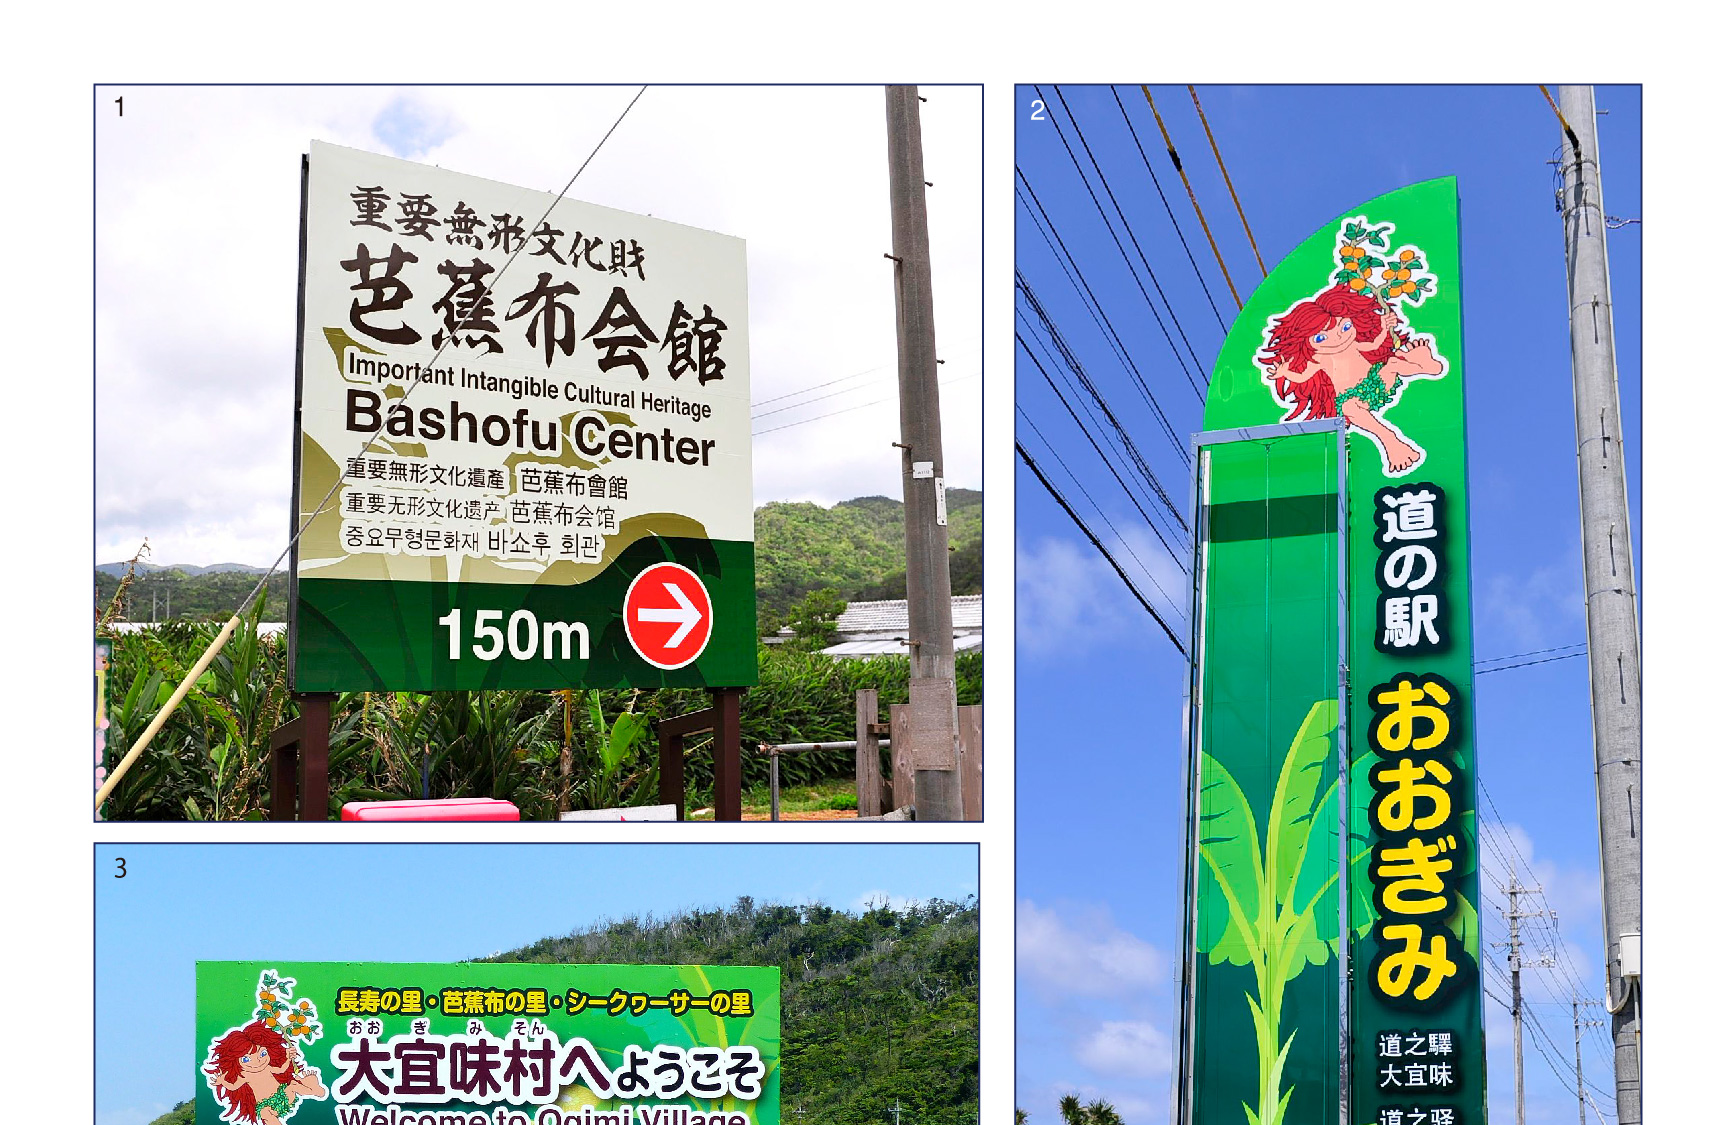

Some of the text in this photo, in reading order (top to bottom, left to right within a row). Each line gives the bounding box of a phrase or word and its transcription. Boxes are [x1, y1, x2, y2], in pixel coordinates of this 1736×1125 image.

[350, 185, 646, 281] 重要無形文化財
[340, 243, 729, 387] 芭蕉布会館
[349, 351, 712, 422] Important Intangible Cultural Heritage
[345, 388, 716, 467] Bashofu Center
[345, 492, 615, 530] 重要无形文化遗产 芭蕉布会馆
[520, 467, 628, 500] 芭蕉布會館
[345, 525, 600, 559] 중요무형문화재 바쇼후 회관
[1382, 489, 1440, 648] 道の駅
[439, 608, 590, 661] 150m
[1376, 680, 1458, 1001] おおぎみ
[349, 1020, 545, 1036] おお ぎ み そん
[1379, 1031, 1453, 1058] 道之驛
[337, 1037, 759, 1097] 大宜味村へようこそ
[1380, 1061, 1454, 1088] 大宜味
